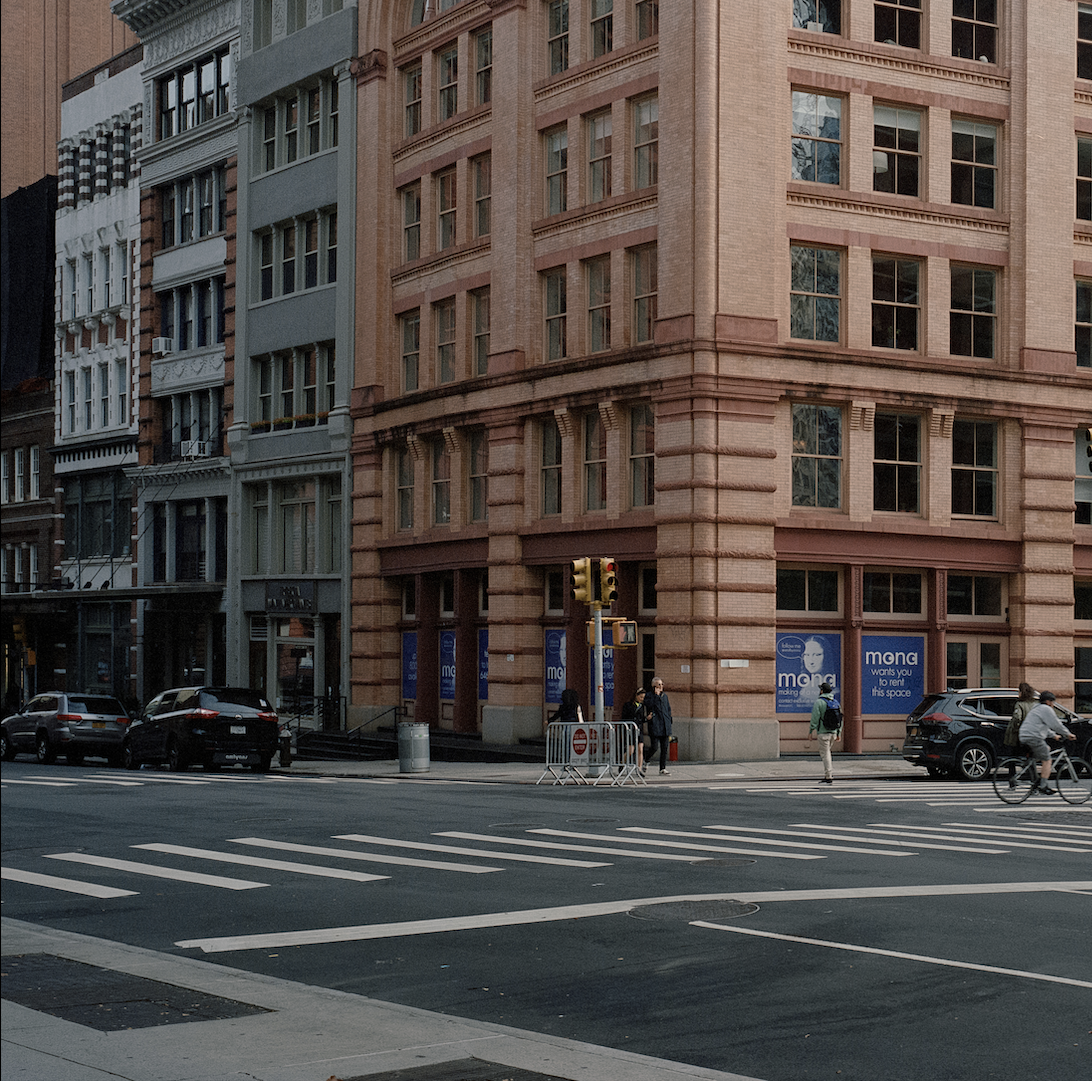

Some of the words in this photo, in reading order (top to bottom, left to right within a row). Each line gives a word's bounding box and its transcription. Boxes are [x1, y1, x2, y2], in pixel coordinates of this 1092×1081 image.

[866, 651, 918, 665] mona
[870, 668, 896, 676] wants
[896, 669, 912, 678] you
[778, 673, 836, 687] mona
[879, 678, 888, 686] to
[889, 678, 904, 686] rent
[872, 686, 884, 697] this
[886, 689, 911, 699] space
